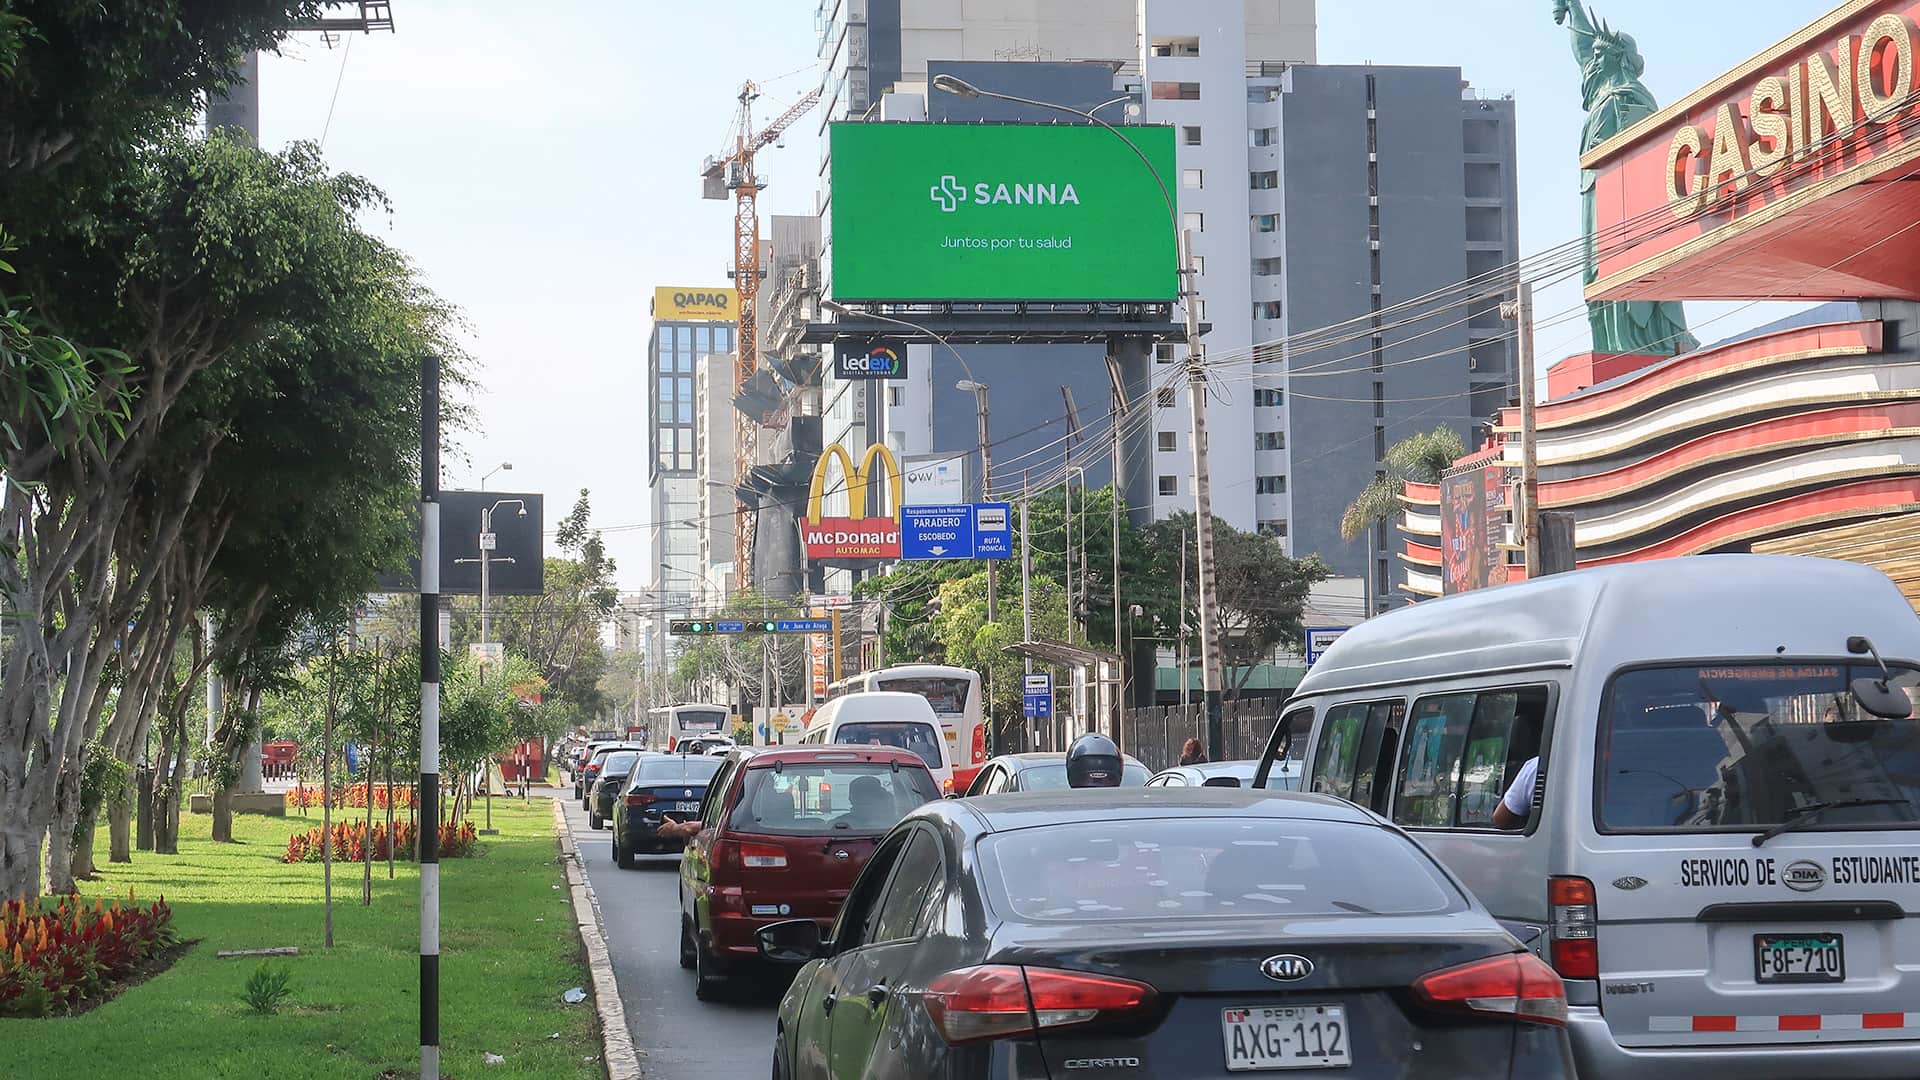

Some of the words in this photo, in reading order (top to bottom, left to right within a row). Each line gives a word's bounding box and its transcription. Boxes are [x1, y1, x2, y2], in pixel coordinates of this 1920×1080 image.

[1665, 13, 1913, 218] CASINO
[974, 183, 1080, 205] SANNA
[941, 236, 988, 248] Juntos
[991, 239, 1015, 251] por
[1019, 237, 1033, 248] tu
[1036, 236, 1072, 248] salud
[673, 292, 728, 309] QAPAQ
[842, 353, 891, 371] ledex
[913, 517, 960, 528] PARADERO
[918, 532, 956, 541] ESCOBEDO
[983, 537, 1001, 545] RUTA
[793, 622, 804, 630] Juan
[805, 622, 811, 630] de
[1681, 858, 1749, 887] SERVICIO
[1756, 858, 1776, 886] DE
[1832, 857, 1920, 885] ESTUDIANTE
[1269, 960, 1307, 977] KIA
[1761, 947, 1838, 974] F8F-710
[1263, 1009, 1305, 1021] PERU
[1233, 1021, 1344, 1060] AXG-112
[1064, 1057, 1140, 1069] CERATO
